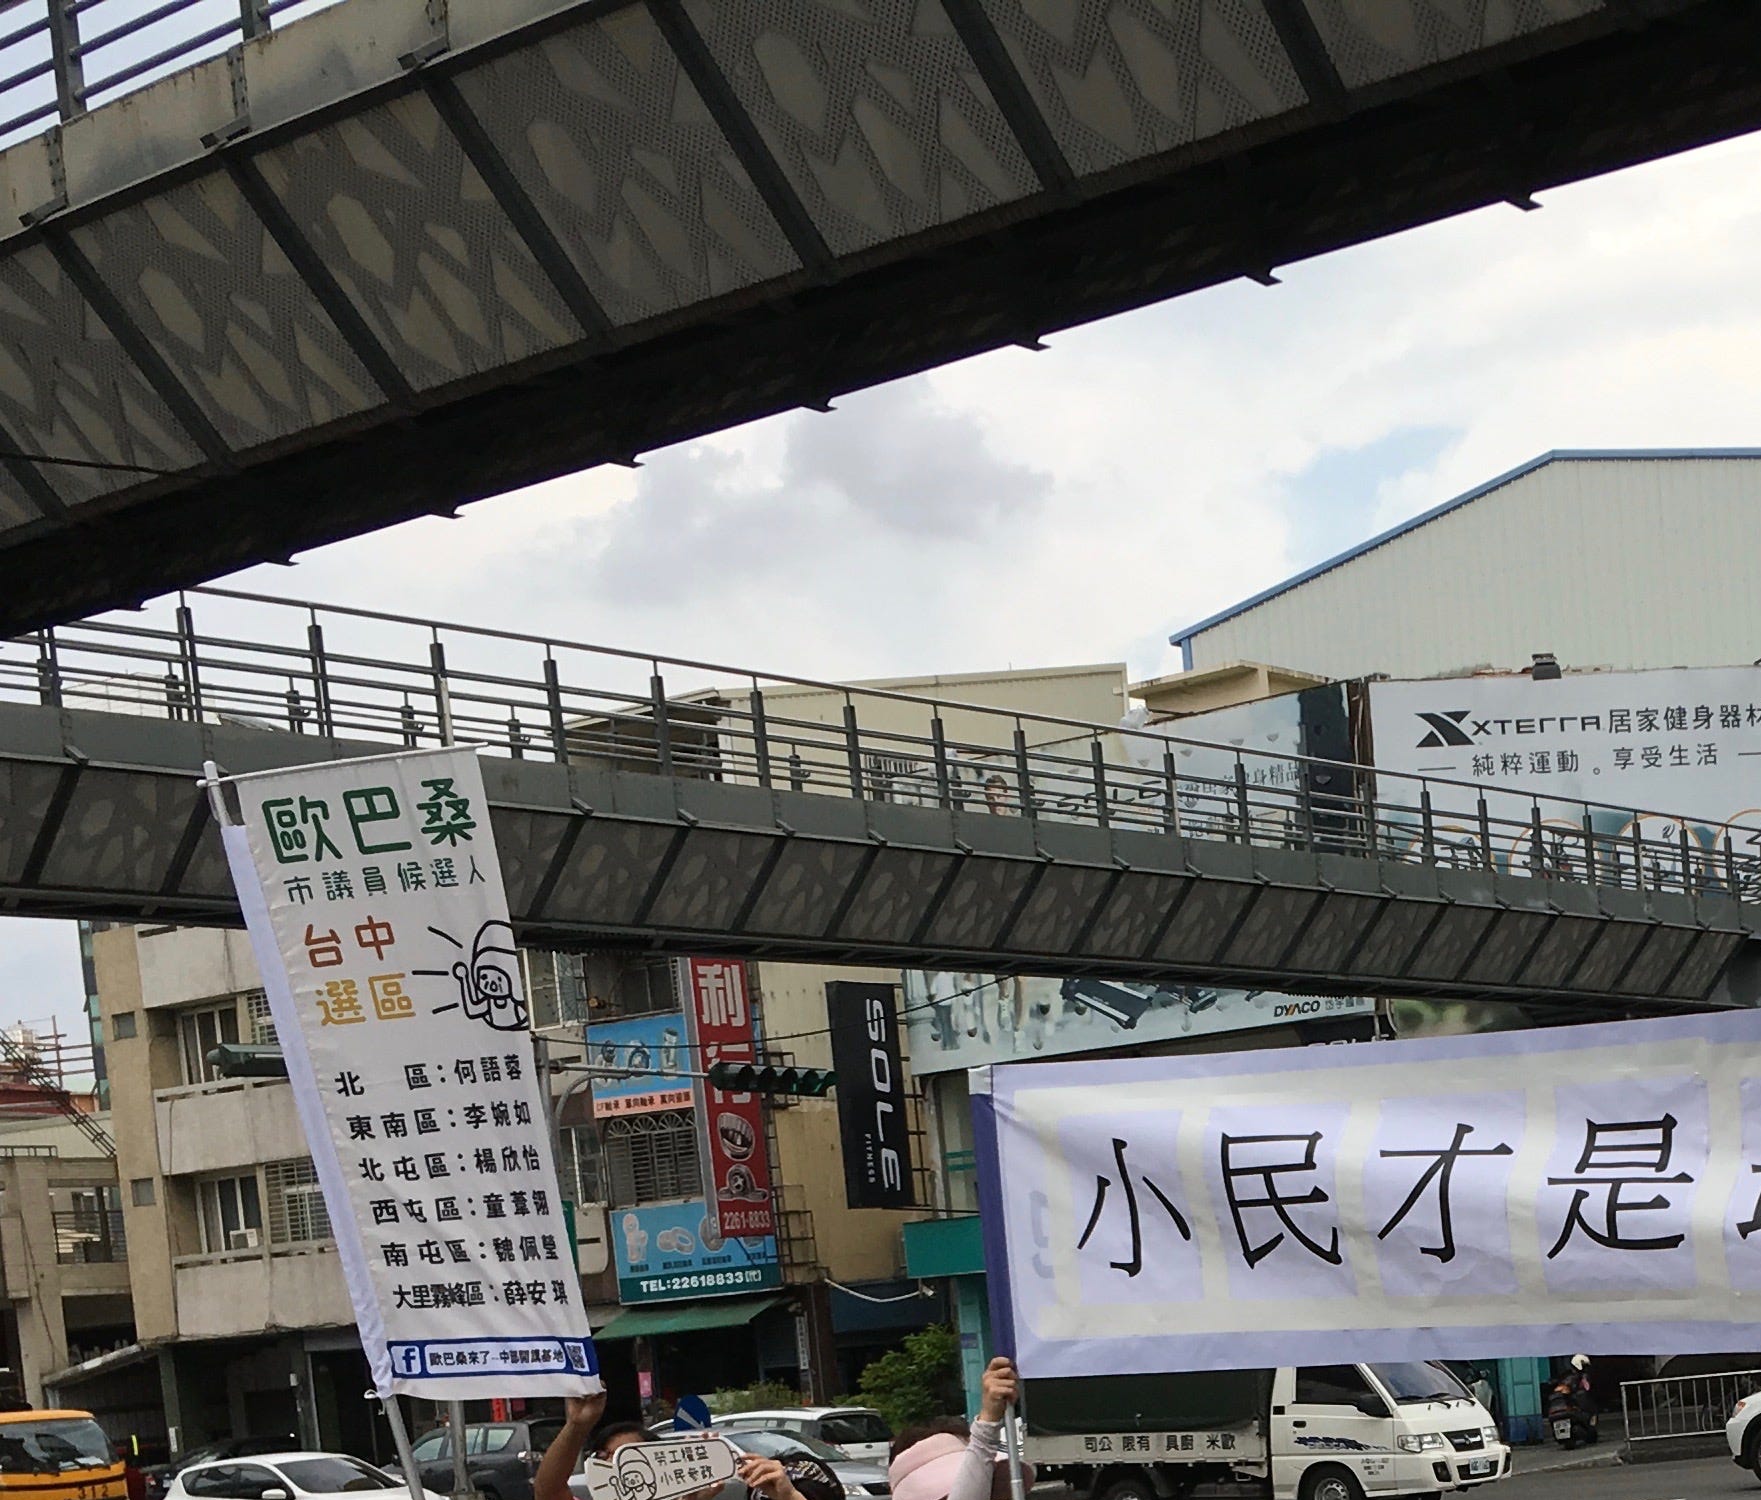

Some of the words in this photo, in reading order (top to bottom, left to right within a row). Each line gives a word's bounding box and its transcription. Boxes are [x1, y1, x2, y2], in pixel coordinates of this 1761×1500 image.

[262, 777, 477, 865] 歐巴桑
[284, 854, 486, 904] 市議員候選人
[305, 916, 395, 967] 台中
[315, 972, 416, 1026] 選區
[1273, 1000, 1320, 1017] DYACO
[866, 999, 900, 1191] SOLE
[77, 1484, 109, 1500] 312
[660, 1465, 714, 1487] 小民參政
